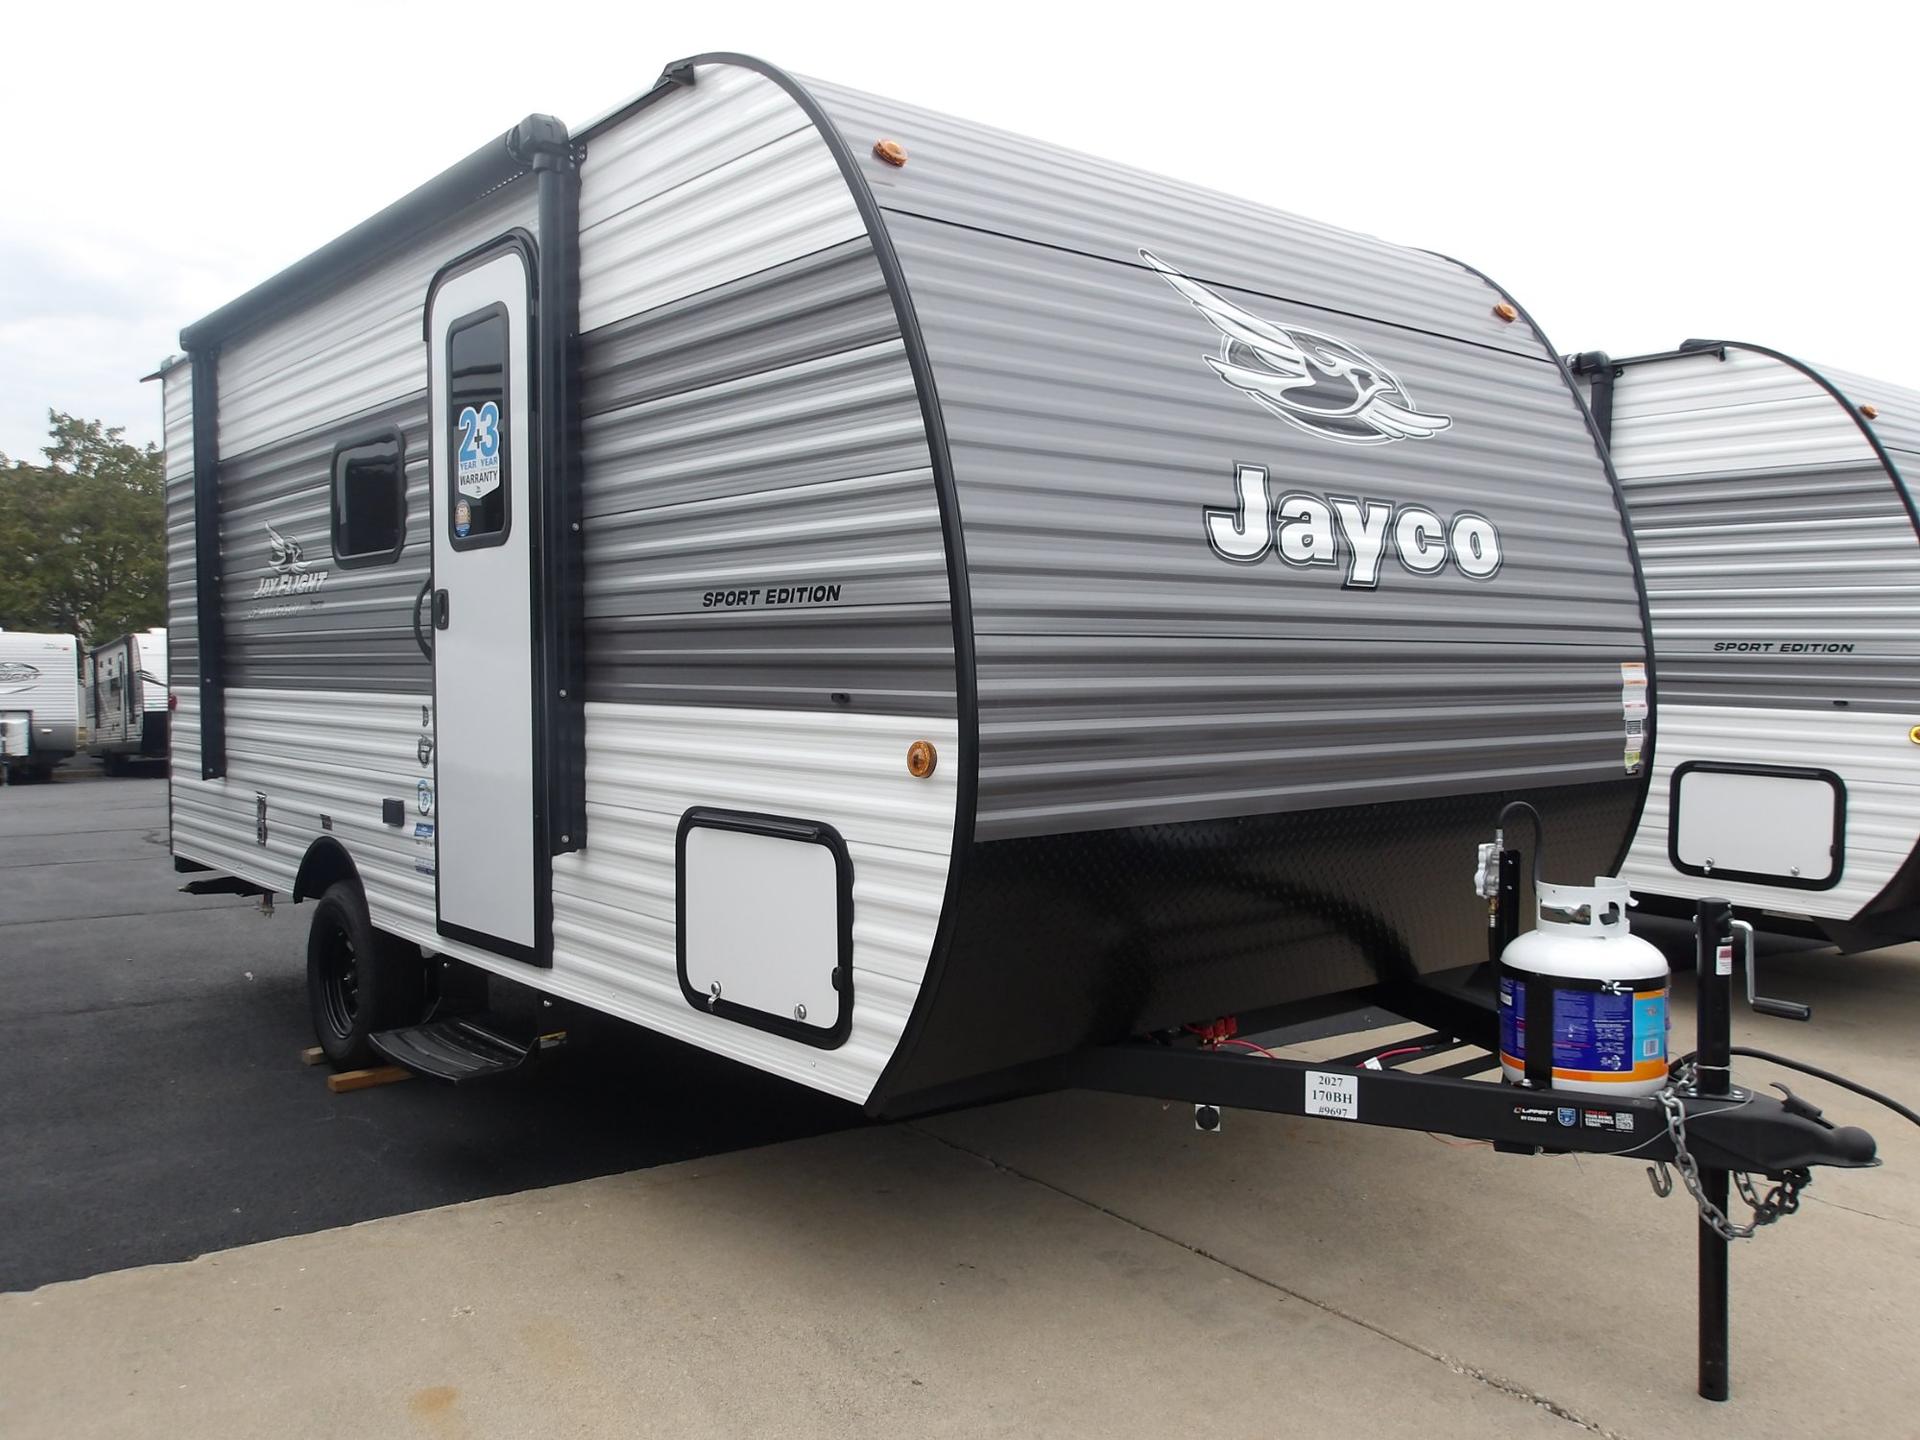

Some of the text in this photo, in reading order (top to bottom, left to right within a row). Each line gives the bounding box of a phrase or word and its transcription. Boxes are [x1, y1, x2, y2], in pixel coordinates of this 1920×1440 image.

[460, 456, 498, 471] YEAR YEAR
[460, 470, 498, 486] WARRANTY
[1203, 461, 1504, 591] Jayco
[253, 572, 328, 598] JAY FLIGHT
[703, 584, 841, 607] SPORT EDITION
[1713, 642, 1855, 653] SPORT EDITION
[1319, 1075, 1343, 1087] 2027
[1313, 1089, 1352, 1104] 170BH
[1319, 1106, 1348, 1117] #9697
